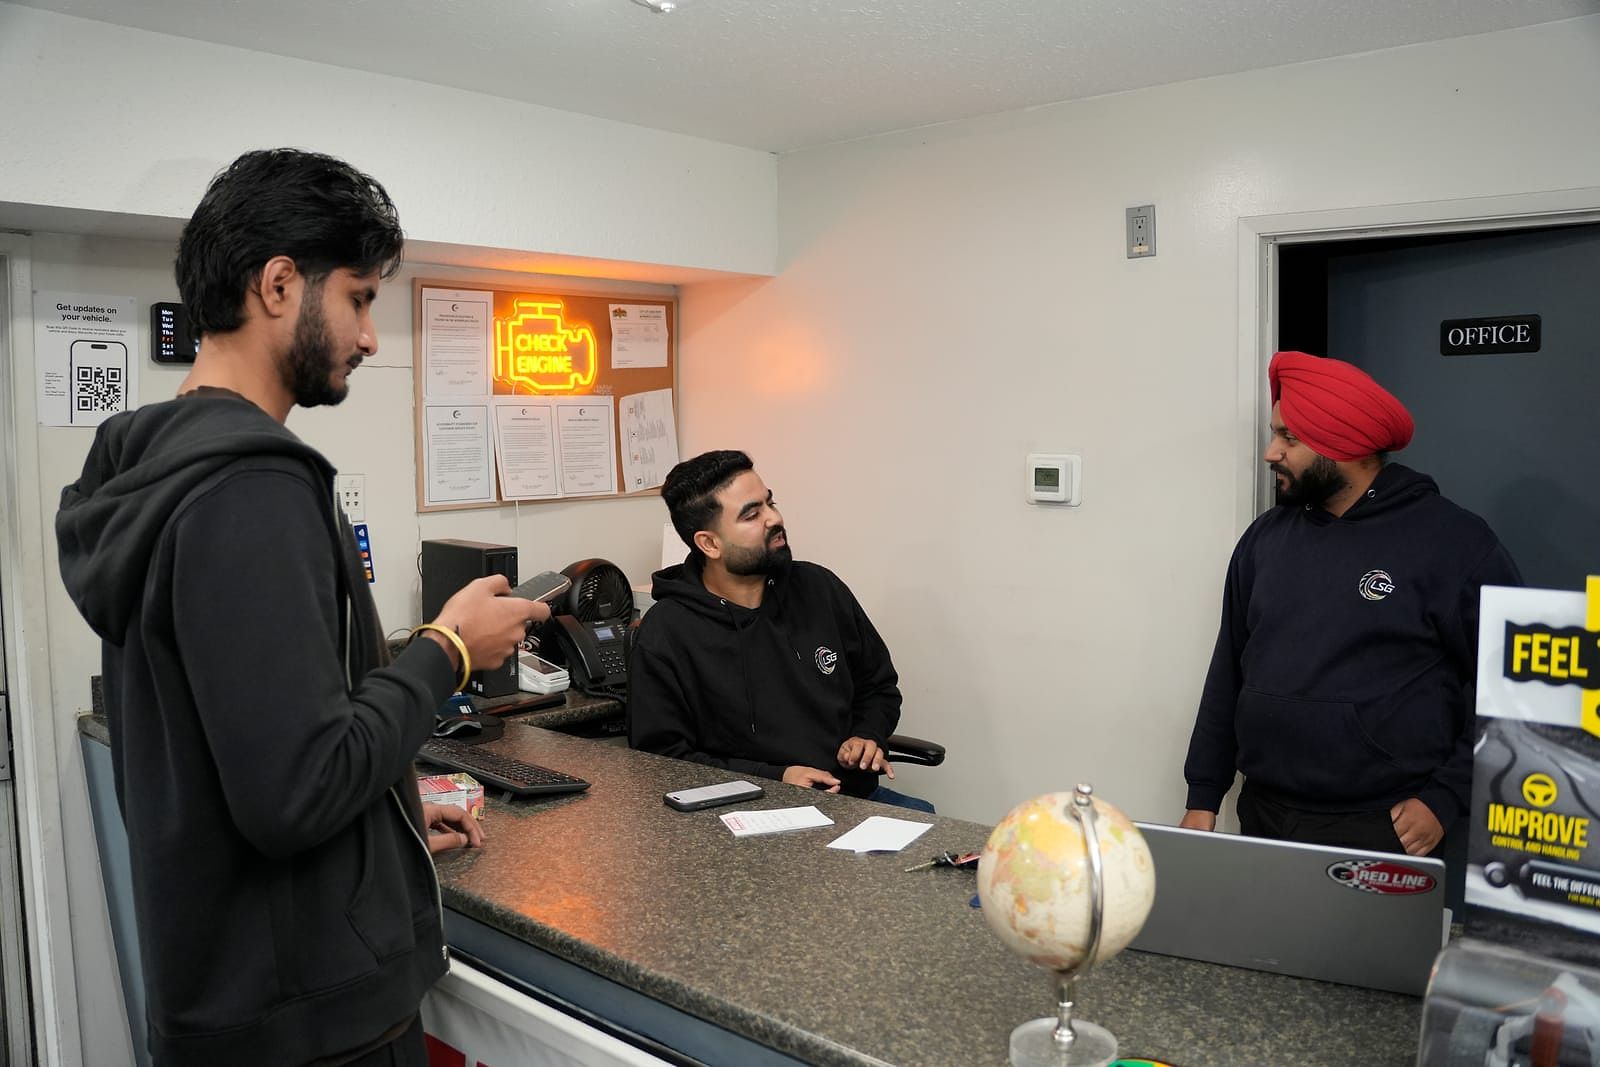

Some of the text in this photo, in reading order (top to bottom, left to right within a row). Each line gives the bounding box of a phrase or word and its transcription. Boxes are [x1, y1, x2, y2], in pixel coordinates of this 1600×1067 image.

[56, 303, 71, 311] Get
[73, 305, 105, 314] updates
[62, 313, 112, 323] your vehicle.
[515, 334, 568, 352] CHECK
[1448, 324, 1530, 346] OFFICE
[517, 356, 572, 373] ENGINE
[1370, 580, 1396, 593] LSG
[823, 652, 837, 665] LSG
[1512, 633, 1588, 678] FEEL
[1488, 803, 1590, 849] IMPROVE
[1492, 835, 1580, 861] CONTROL AND HANDLING
[1359, 870, 1389, 882] RED
[1392, 873, 1427, 887] LINE
[1533, 872, 1552, 888] FEEL
[1553, 876, 1569, 891] THE
